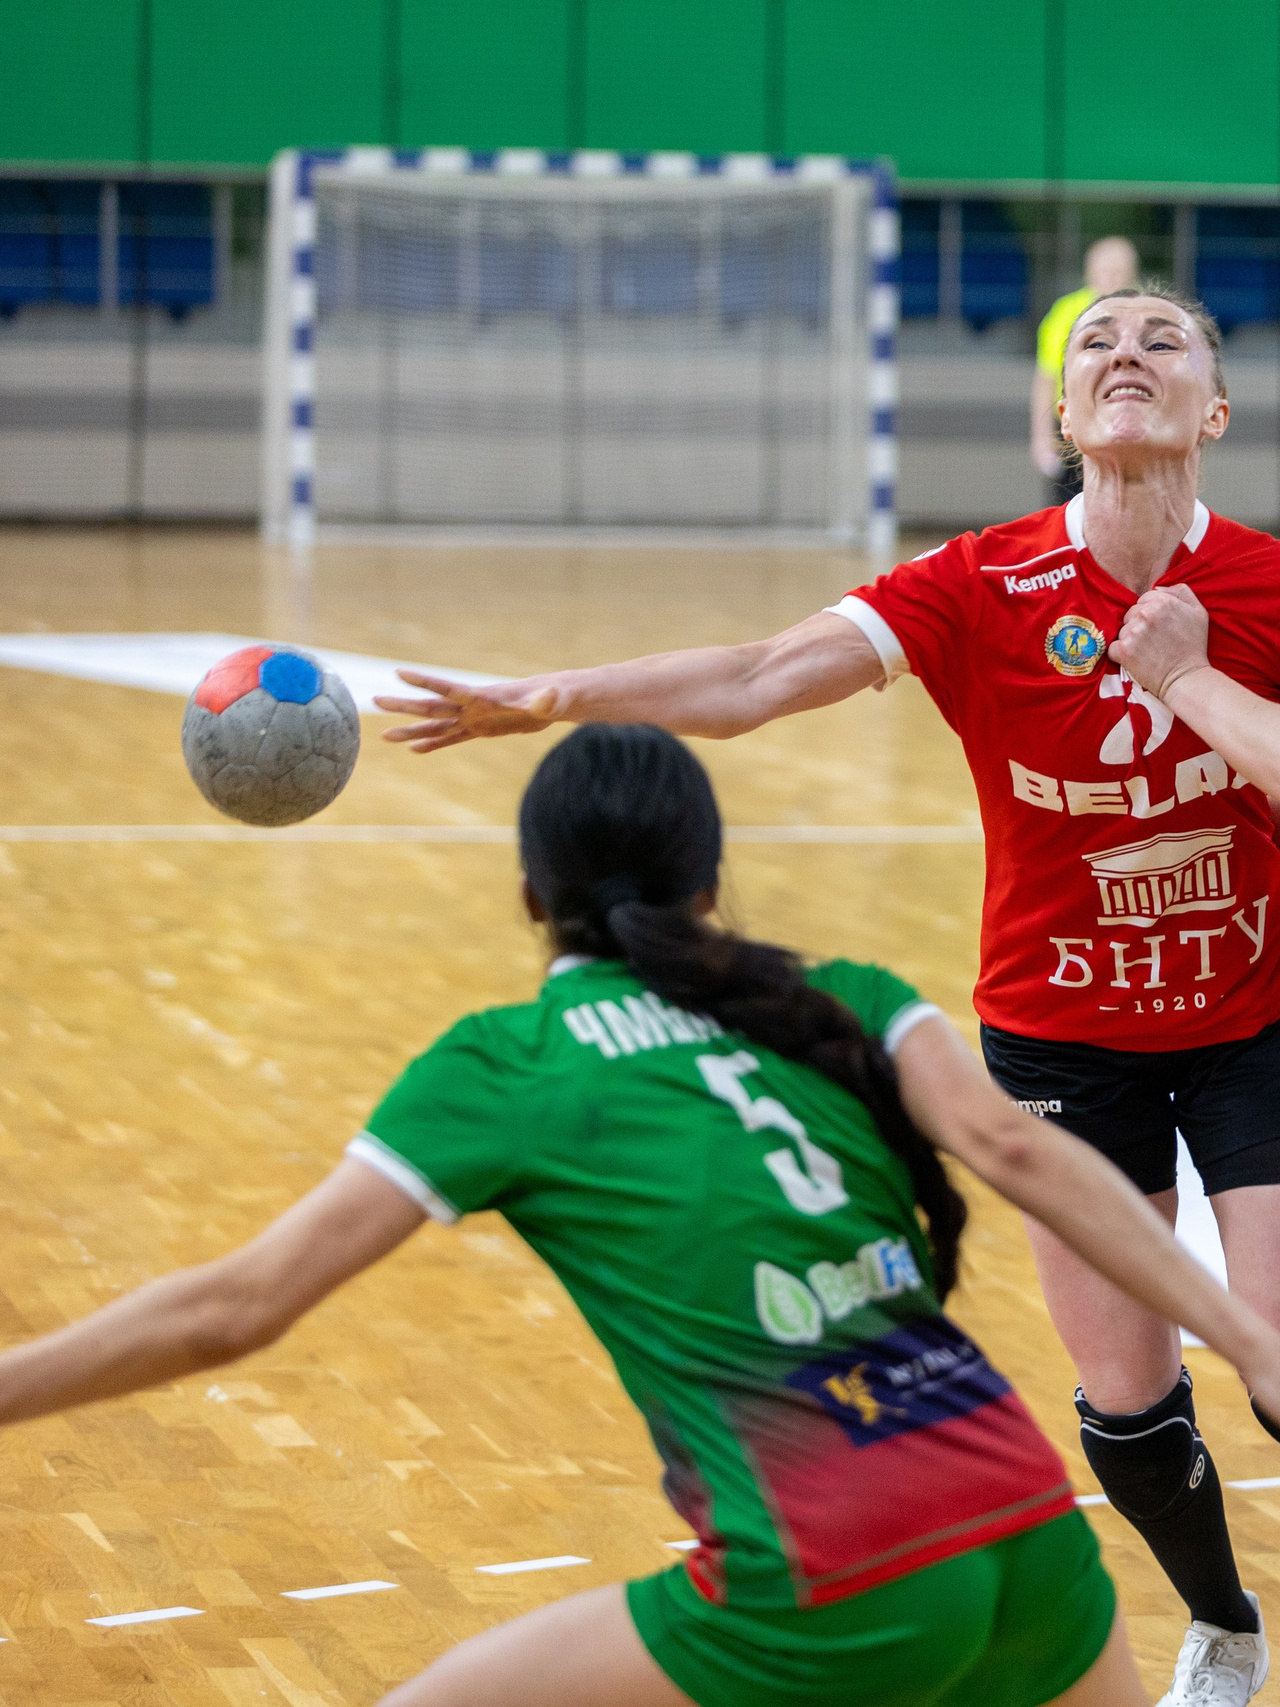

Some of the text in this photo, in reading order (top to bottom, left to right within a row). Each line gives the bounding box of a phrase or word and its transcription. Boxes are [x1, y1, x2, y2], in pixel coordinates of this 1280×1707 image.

[1003, 563, 1077, 595] Kempa
[1008, 750, 1251, 820] BELA
[1048, 895, 1269, 989] БНТУ
[1134, 992, 1207, 1014] 1920
[694, 1049, 850, 1217] 5
[1010, 1099, 1063, 1117] mpa
